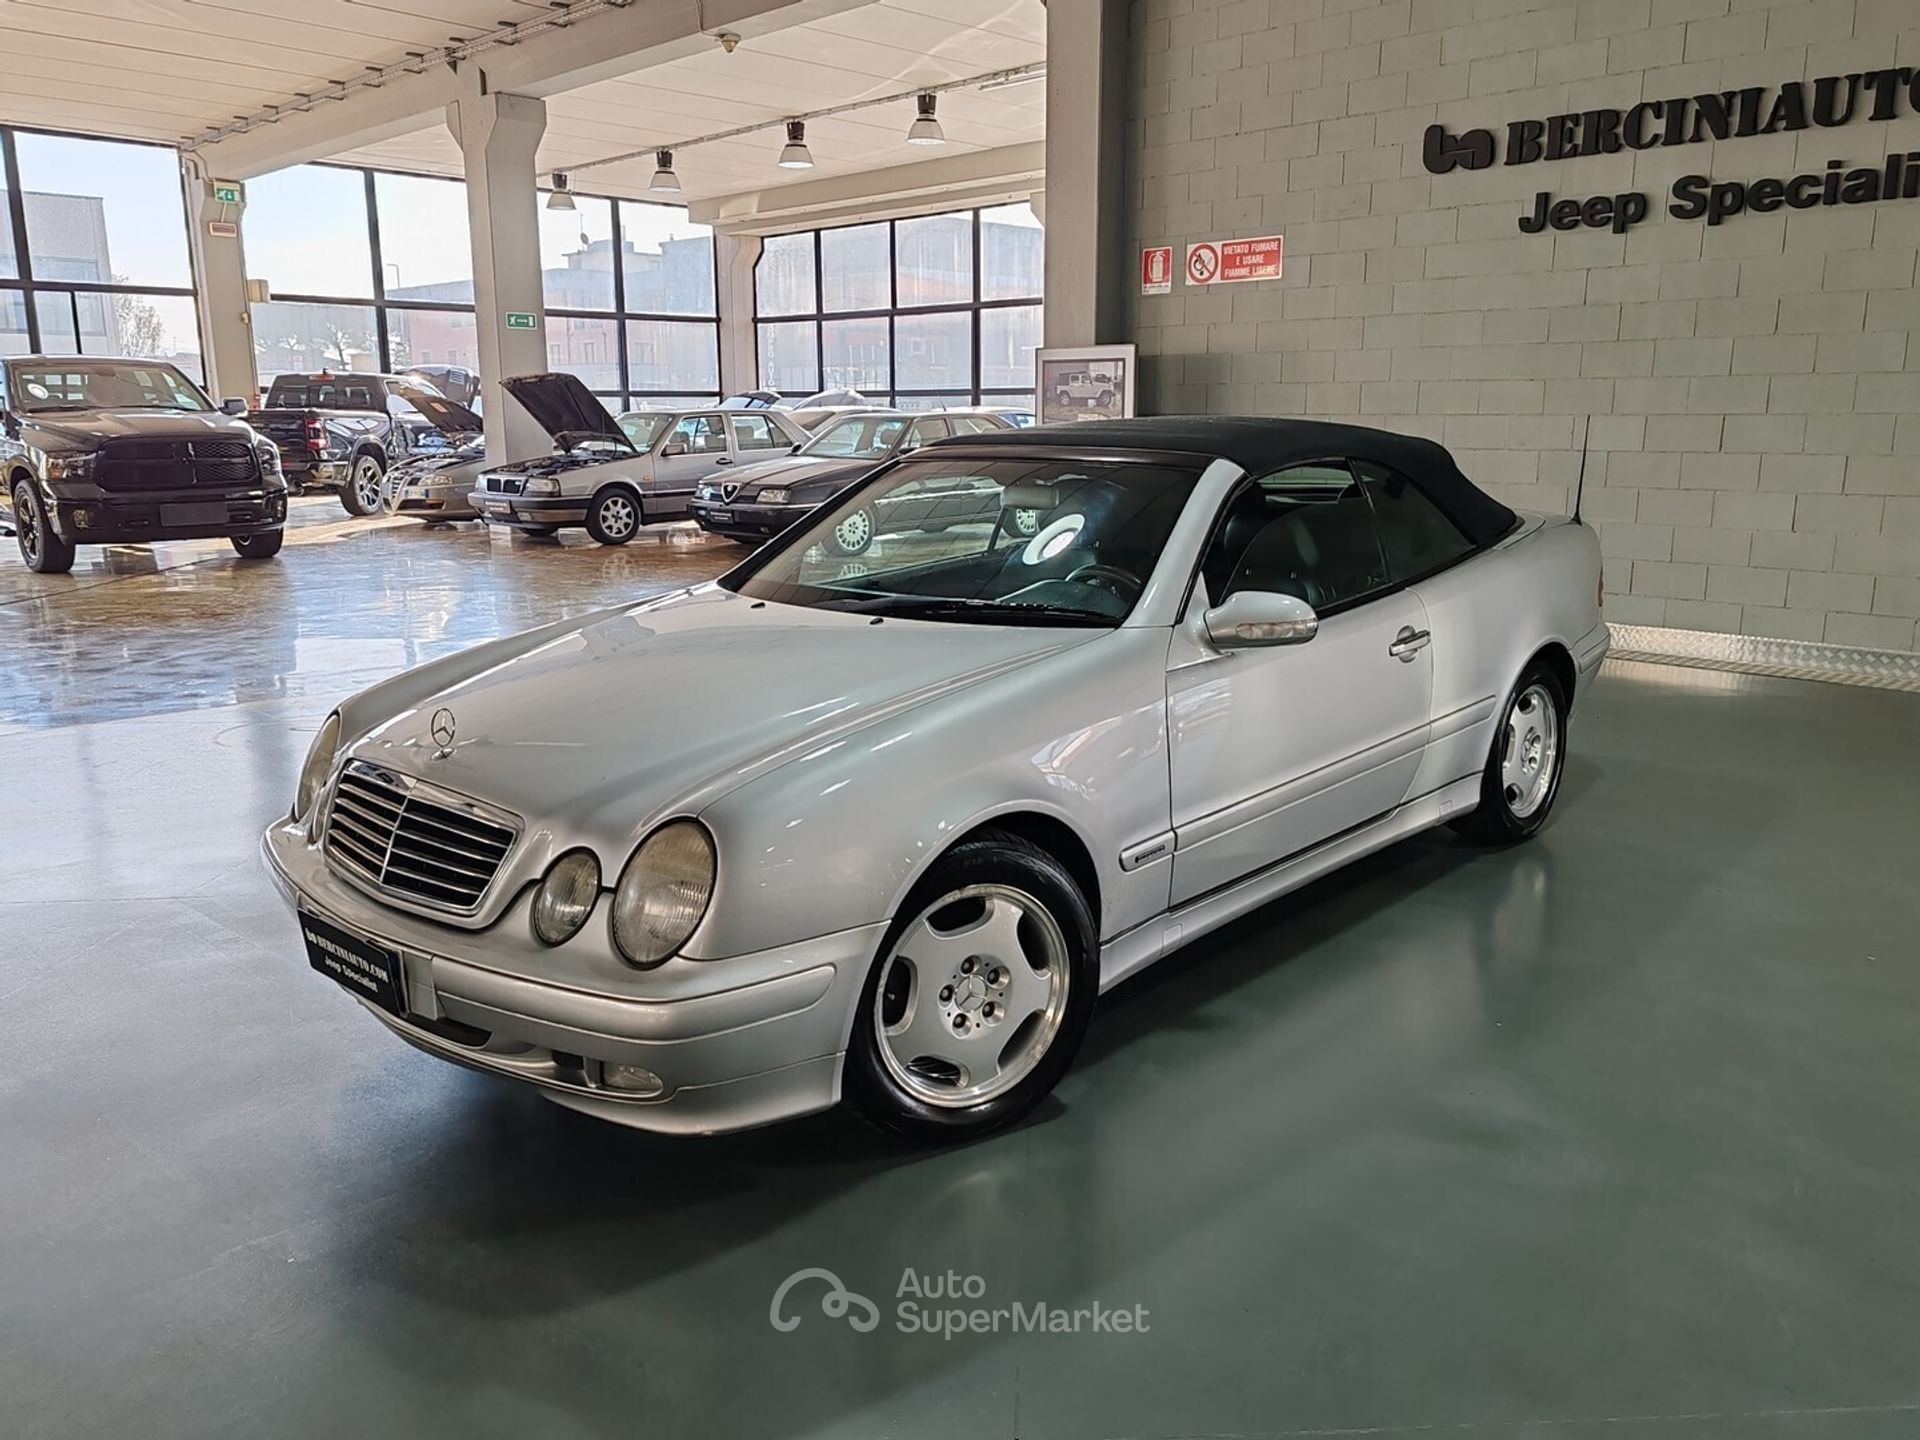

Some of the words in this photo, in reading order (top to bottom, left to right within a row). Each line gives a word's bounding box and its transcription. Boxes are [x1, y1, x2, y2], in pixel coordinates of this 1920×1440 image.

[1518, 191, 1648, 234] Jeep
[1668, 152, 1920, 226] Speciali
[1223, 243, 1249, 255] VIETATO
[1251, 240, 1279, 253] FUMARE
[1236, 256, 1241, 265] E
[1242, 254, 1264, 265] USARE
[1224, 265, 1250, 277] FIAMME
[1252, 264, 1278, 275] LIBERE
